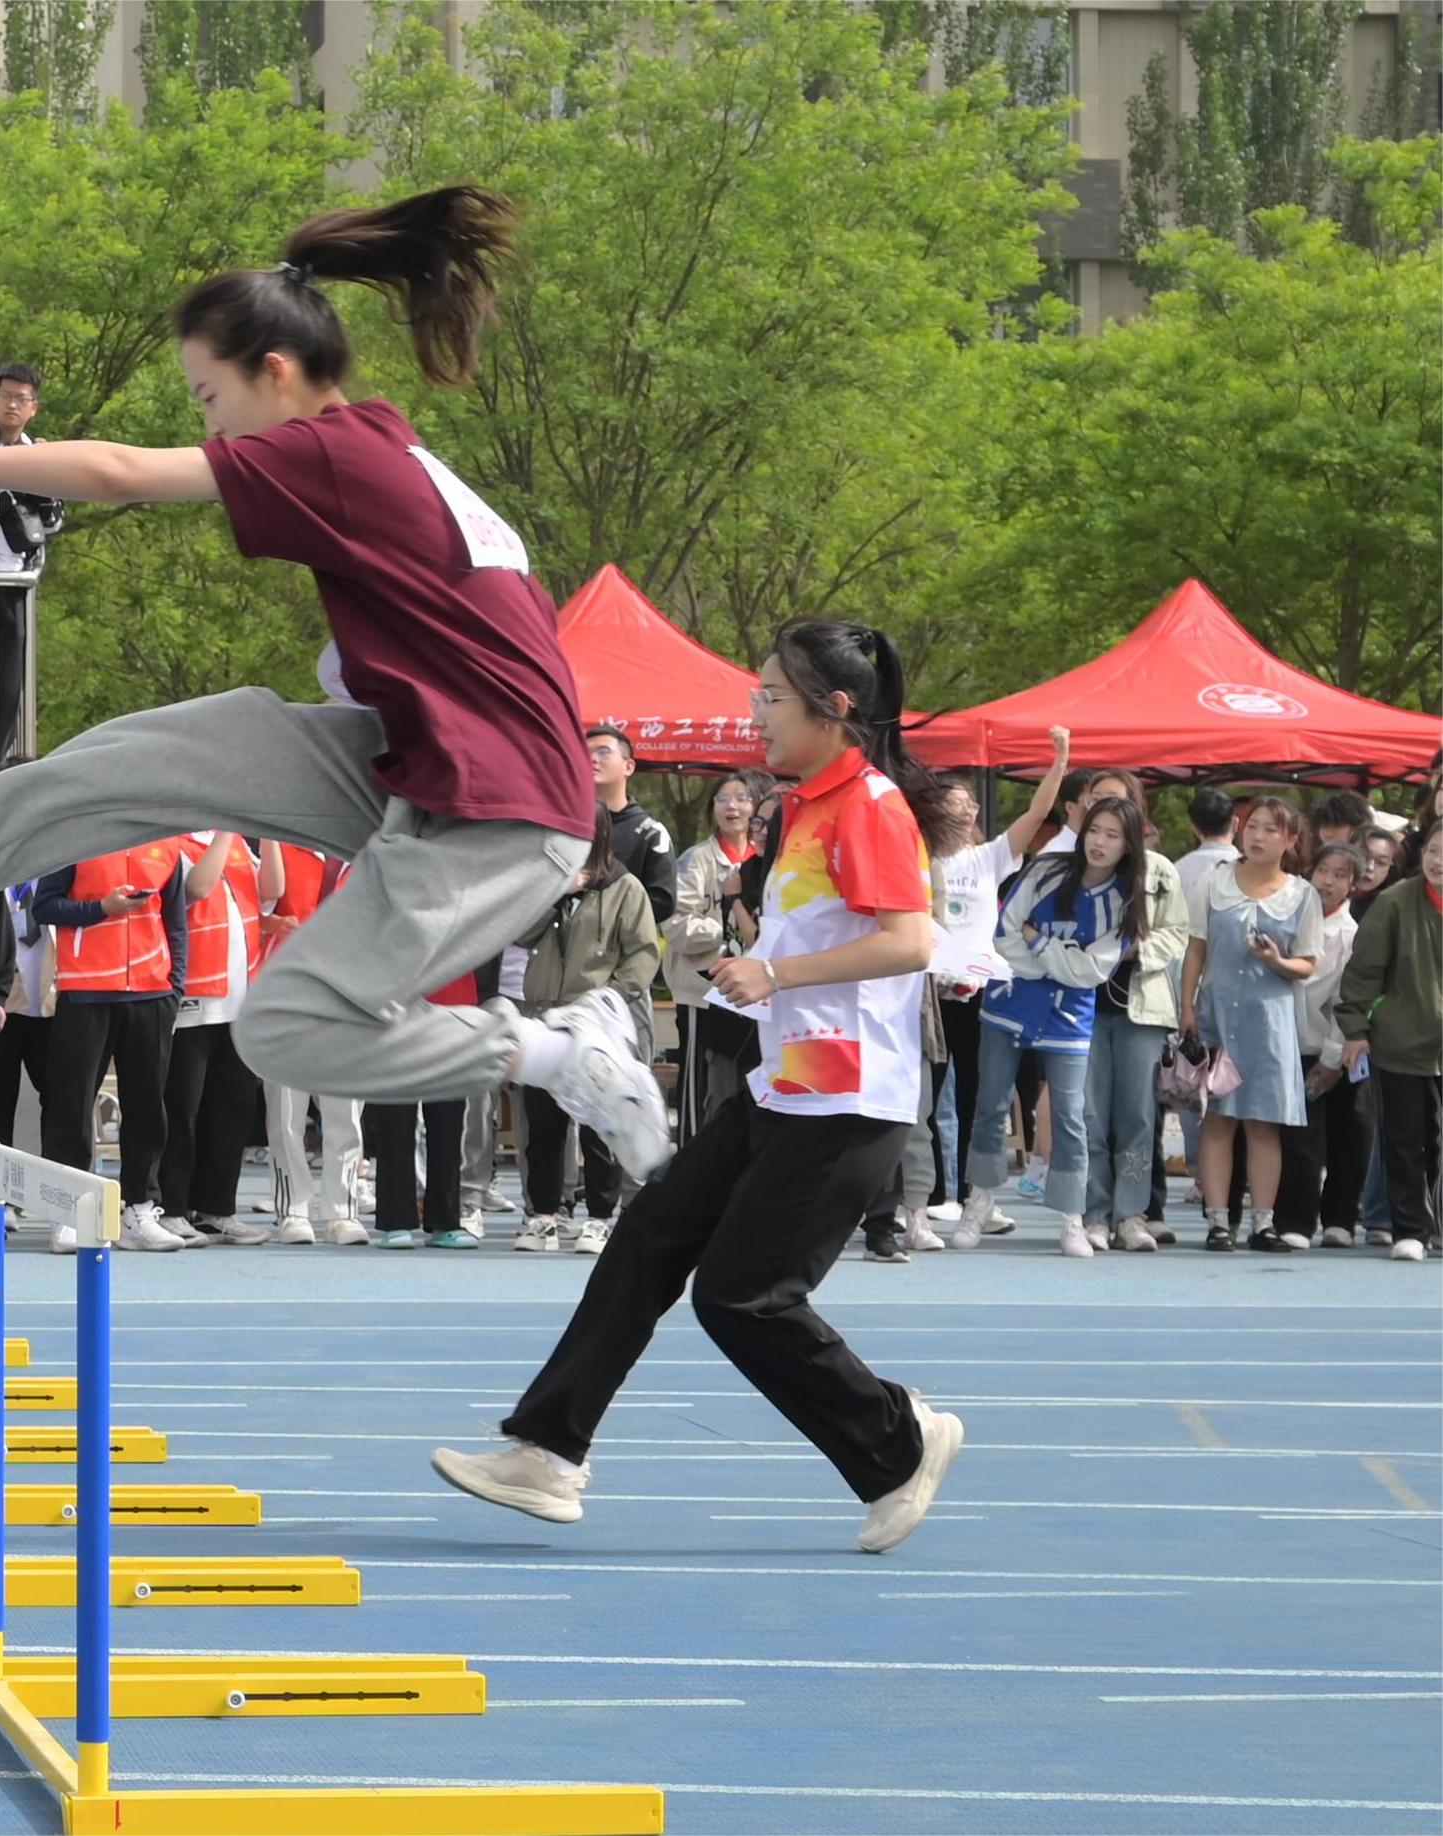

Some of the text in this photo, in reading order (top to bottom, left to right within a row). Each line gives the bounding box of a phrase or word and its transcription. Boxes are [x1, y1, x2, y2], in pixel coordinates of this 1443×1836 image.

[635, 742, 757, 752] COLLEGE OF TECHNOLOGY
